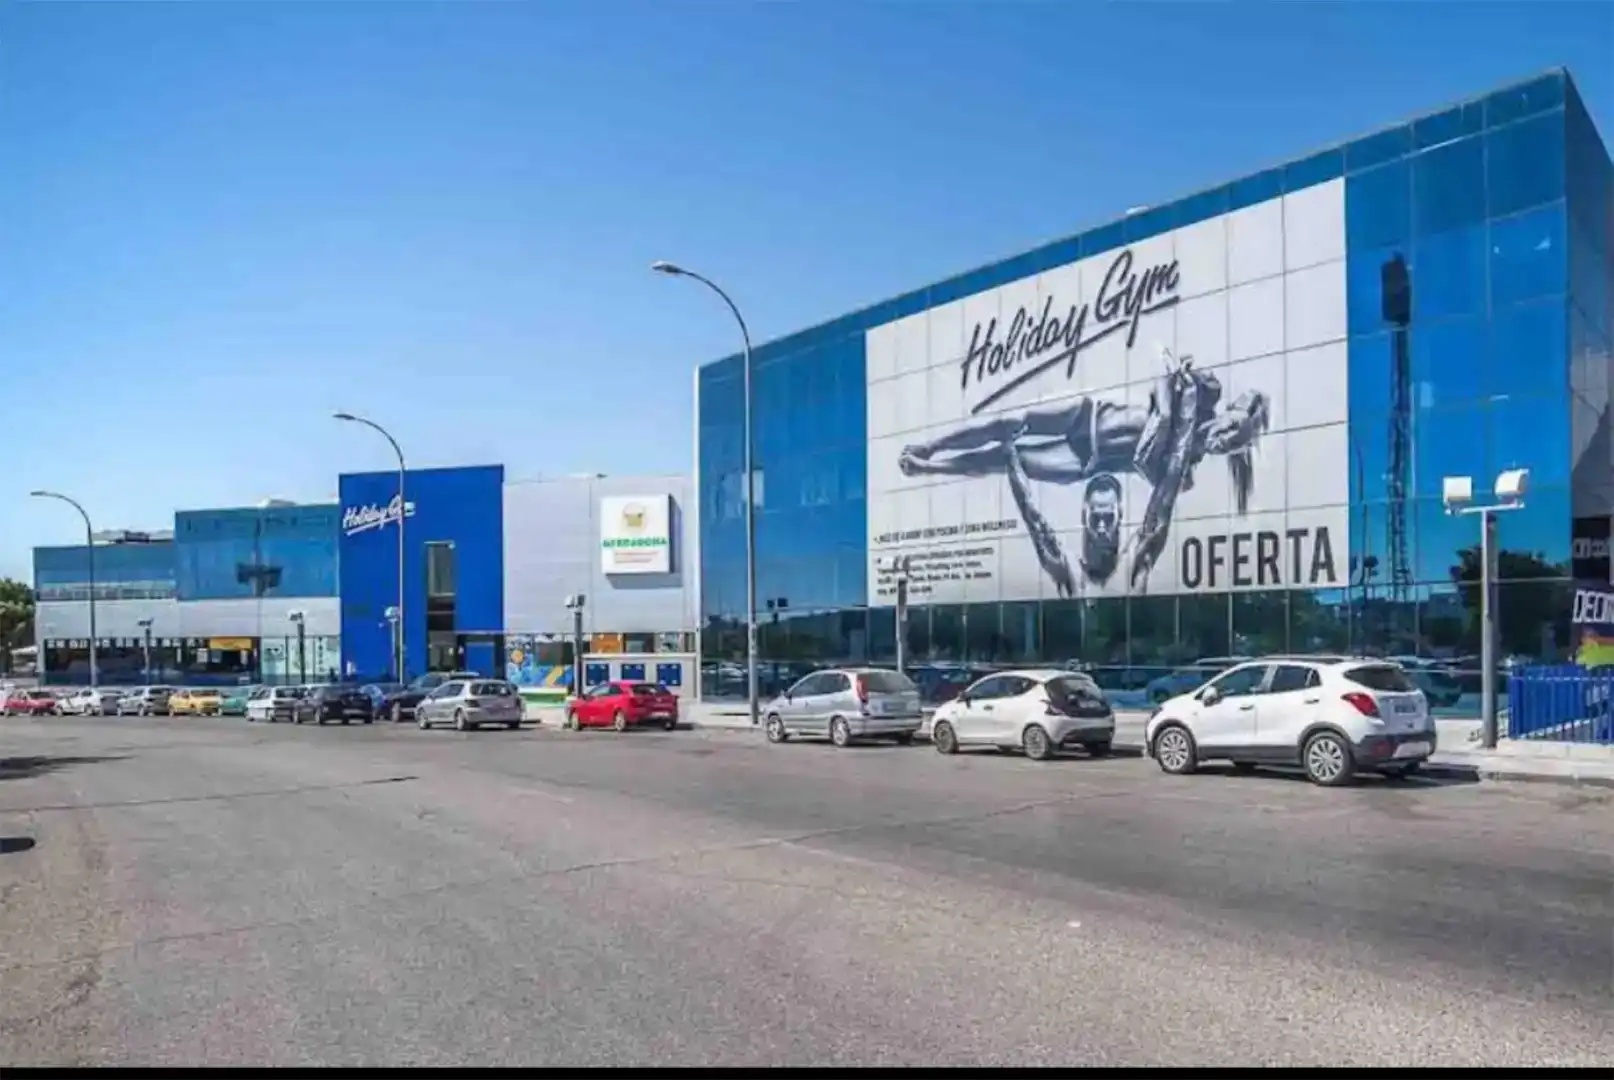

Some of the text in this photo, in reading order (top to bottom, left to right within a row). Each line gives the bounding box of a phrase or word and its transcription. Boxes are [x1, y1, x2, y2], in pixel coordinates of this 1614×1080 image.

[960, 250, 1181, 389] Holiday Gym
[1182, 526, 1337, 588] OFERTA
